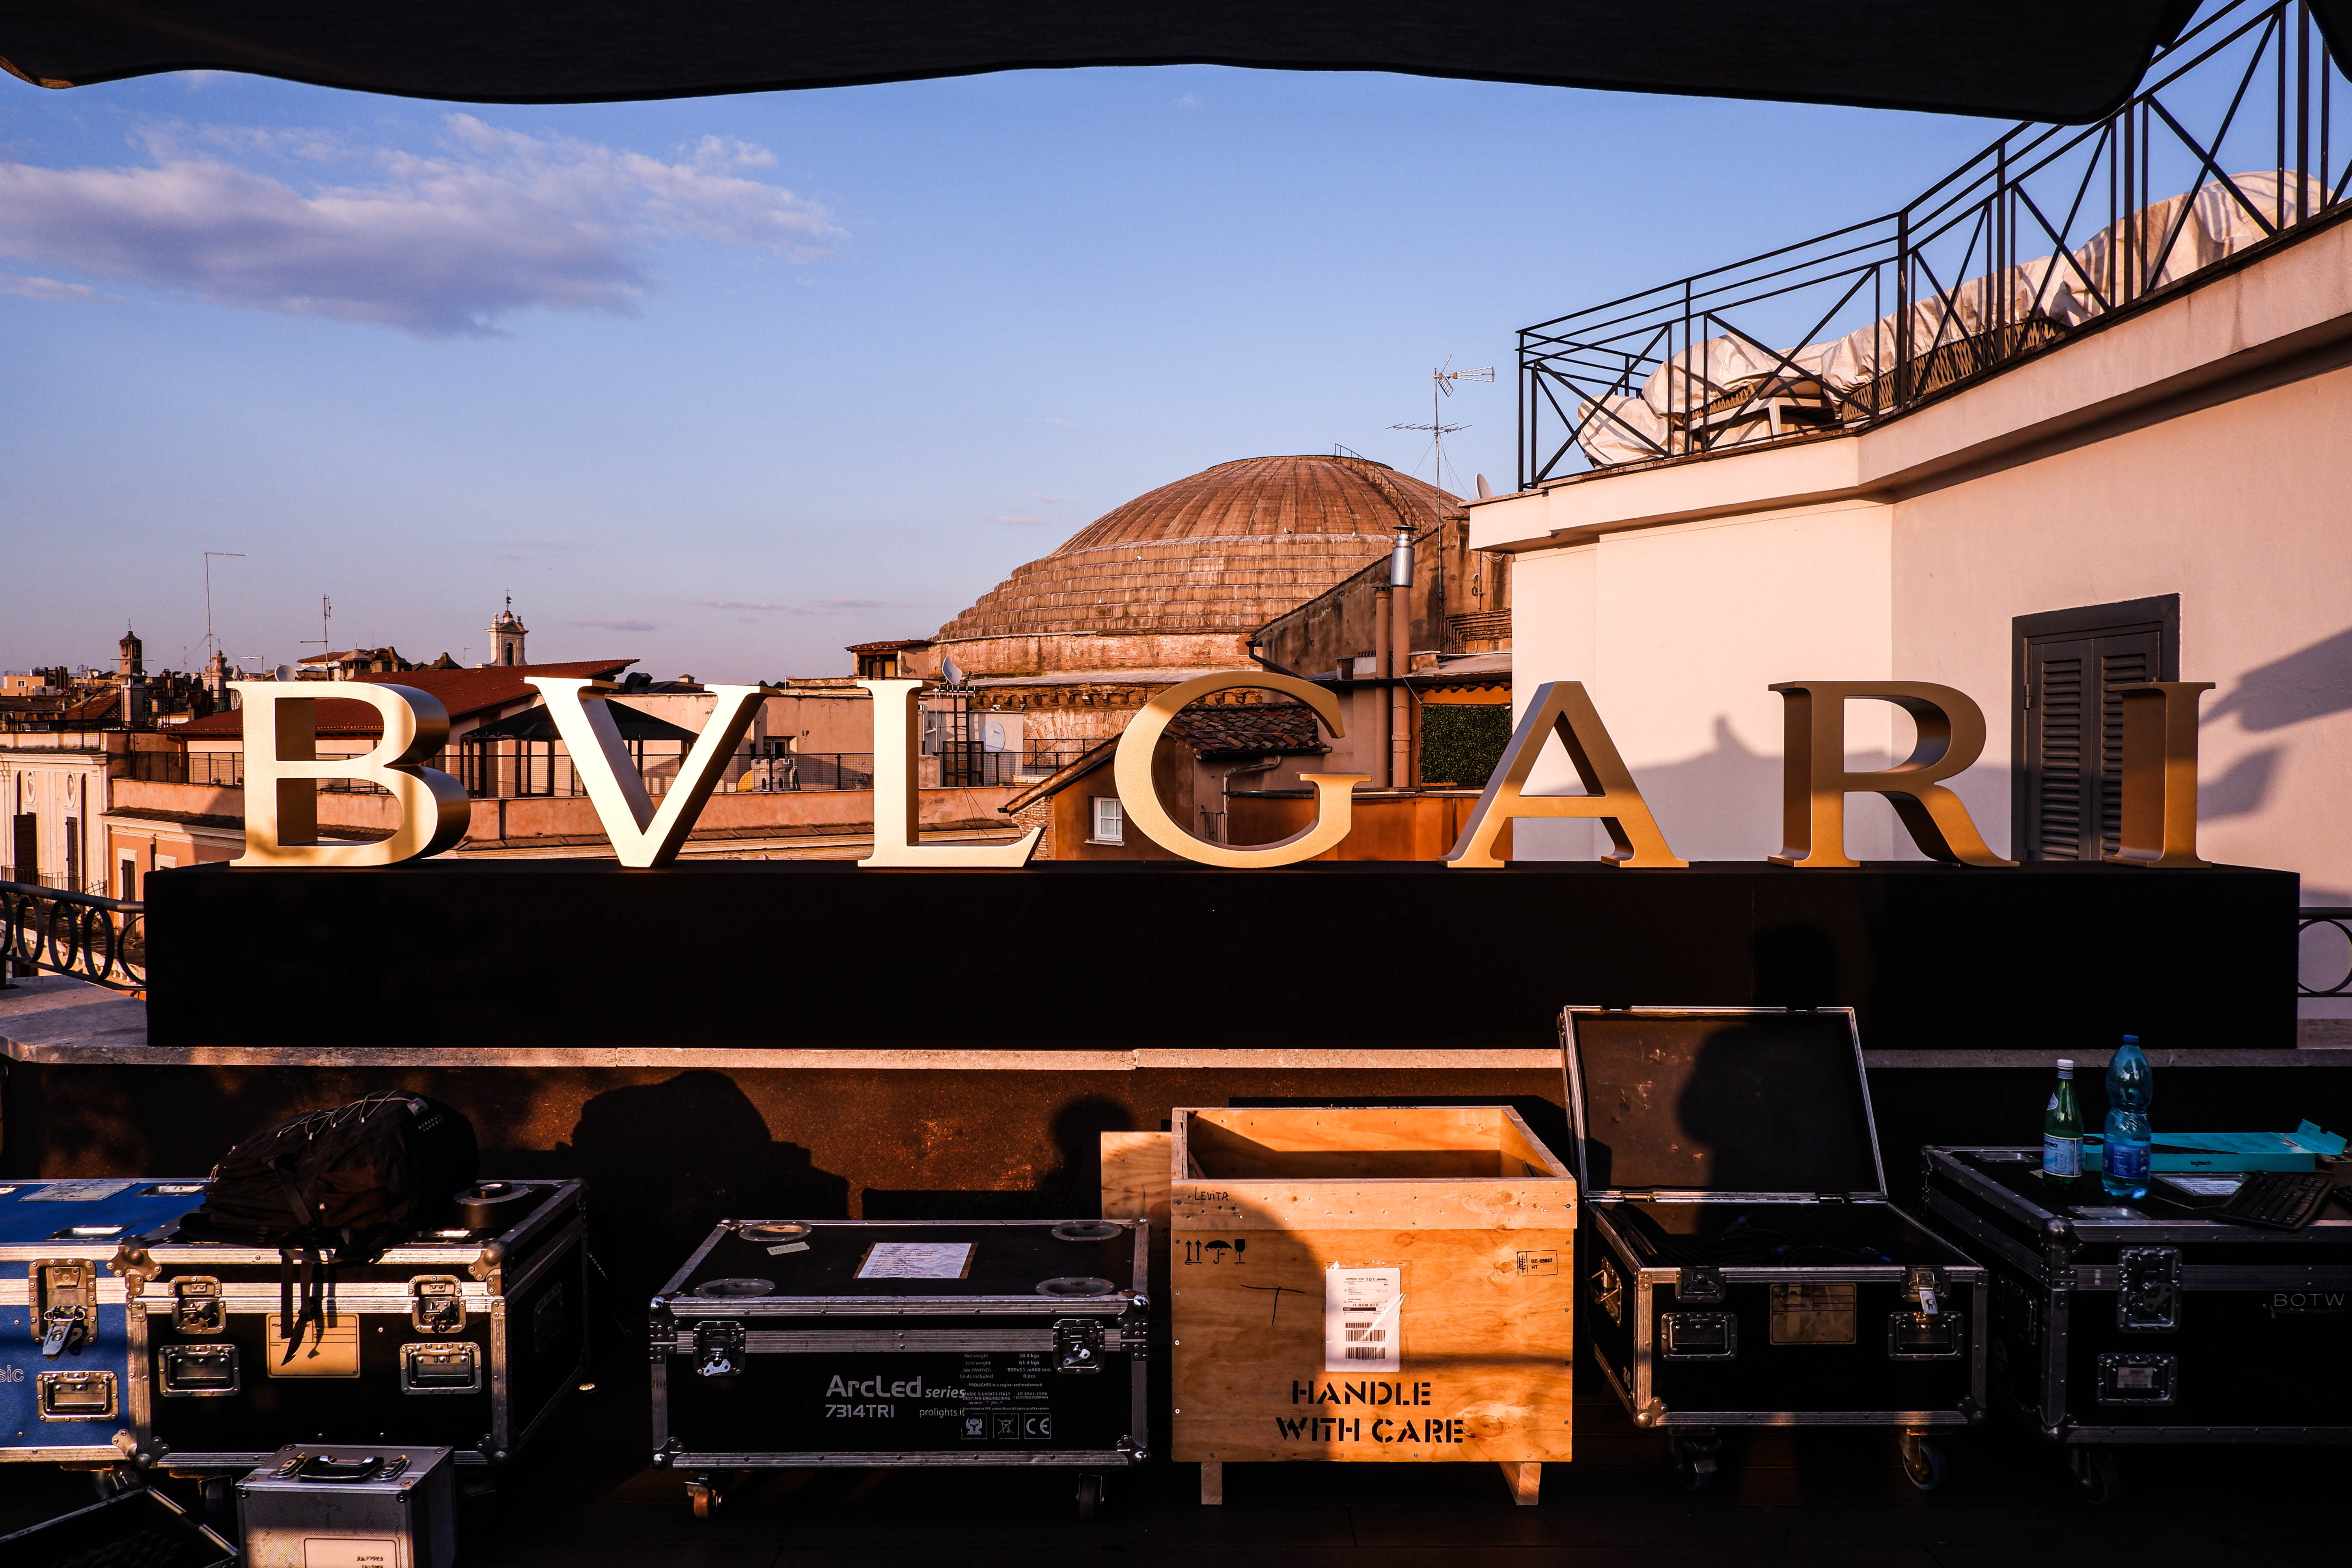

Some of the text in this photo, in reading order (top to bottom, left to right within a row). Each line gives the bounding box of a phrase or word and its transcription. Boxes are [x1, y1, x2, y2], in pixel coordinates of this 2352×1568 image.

[226, 670, 2216, 869] BVLGARI
[925, 1385, 966, 1398] series
[1293, 1380, 1431, 1406] HANDLE
[825, 1404, 894, 1418] 7314TRI
[919, 1408, 966, 1418] prolights.it
[1026, 1418, 1049, 1434] CE
[1275, 1417, 1464, 1443] WITH CARE
